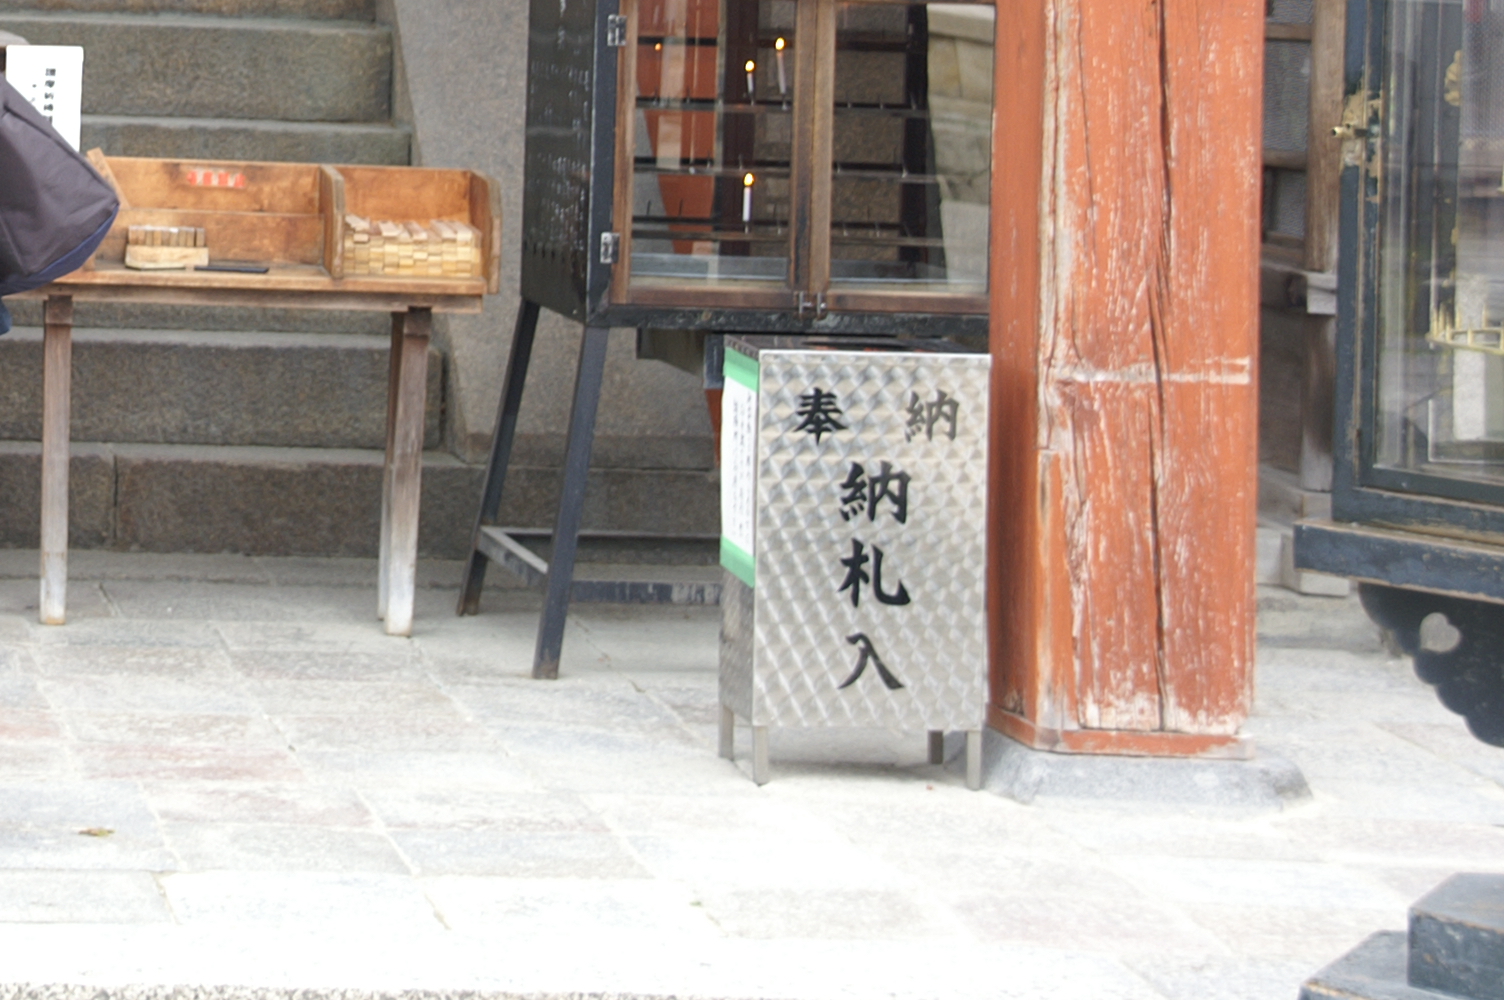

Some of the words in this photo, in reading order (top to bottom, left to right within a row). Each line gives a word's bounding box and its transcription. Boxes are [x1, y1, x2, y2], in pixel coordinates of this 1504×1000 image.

[794, 388, 848, 445] 奉
[904, 389, 960, 443] 納
[838, 461, 911, 689] 納札入
